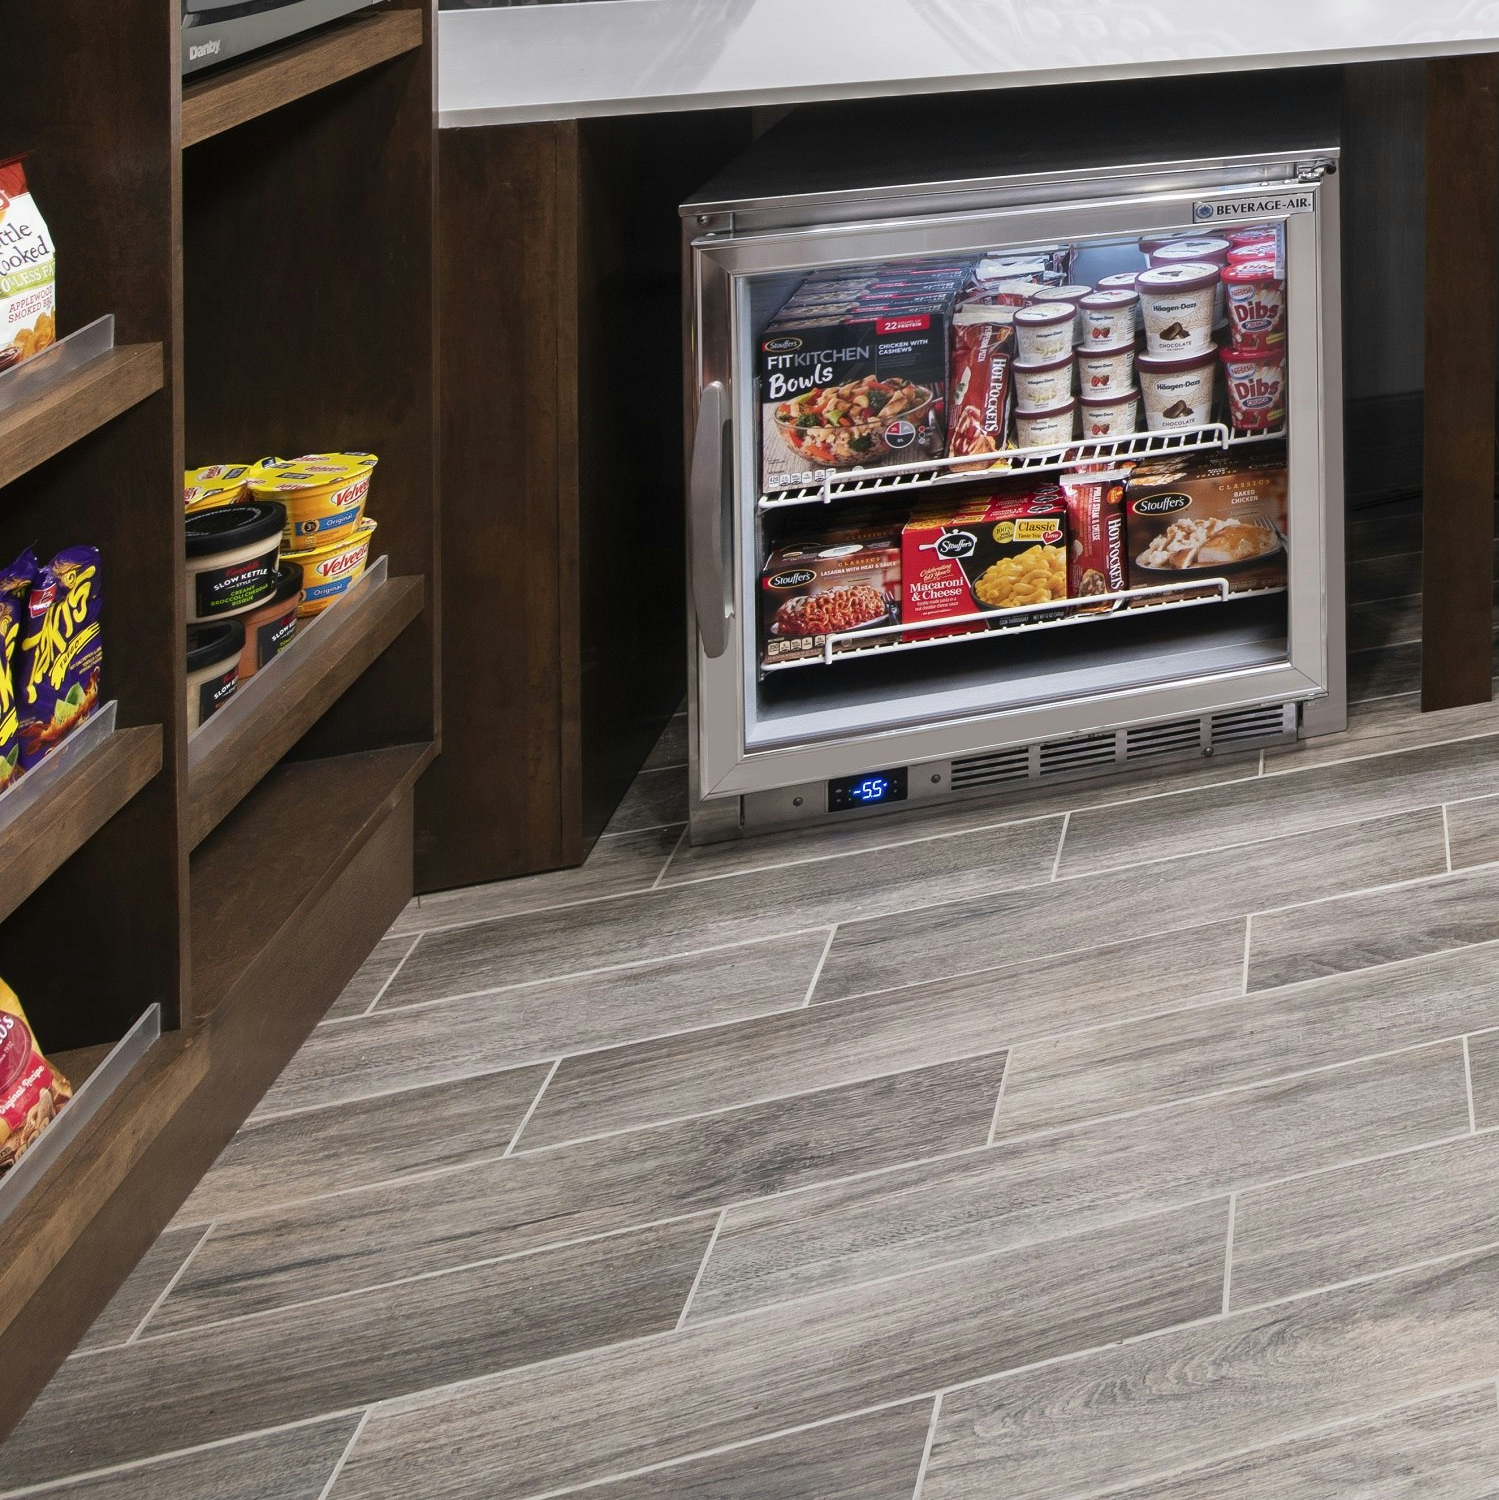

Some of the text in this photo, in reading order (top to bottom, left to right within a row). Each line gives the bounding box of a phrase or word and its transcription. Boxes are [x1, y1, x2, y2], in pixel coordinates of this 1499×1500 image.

[189, 38, 221, 60] Danby
[1216, 197, 1308, 216] BEVERAGE-AIR
[16, 268, 42, 286] LESS
[9, 285, 53, 314] APPLEWOOD
[8, 301, 42, 324] SMOKED
[1233, 300, 1280, 323] Dibs
[884, 321, 898, 331] 22
[769, 338, 798, 351] Stouffer's
[878, 338, 929, 351] CHICKEN WITH
[878, 346, 913, 356] CASHEWS
[1158, 340, 1192, 349] CHOCOLATE
[769, 363, 834, 399] Bowls
[1234, 378, 1280, 398] Dibs
[1161, 418, 1196, 428] CHOCOLATE
[1218, 478, 1271, 491] CLASSICS
[1231, 494, 1259, 505] CHICKEN
[1233, 489, 1256, 498] BAKED
[1140, 495, 1185, 513] Stouffer's
[326, 513, 353, 527] Original
[1017, 521, 1056, 533] Classic
[940, 536, 973, 554] Stouffer's
[1107, 516, 1125, 590] HOT POCKETS
[773, 572, 811, 586] Stouffer's
[820, 567, 846, 577] LASAGNA
[213, 568, 268, 592] SLOW KETTLE
[909, 576, 964, 594] Macaroni
[230, 584, 256, 597] CREAMY
[313, 583, 343, 597] Original
[911, 586, 963, 602] & Cheese
[213, 680, 232, 700] SLOW
